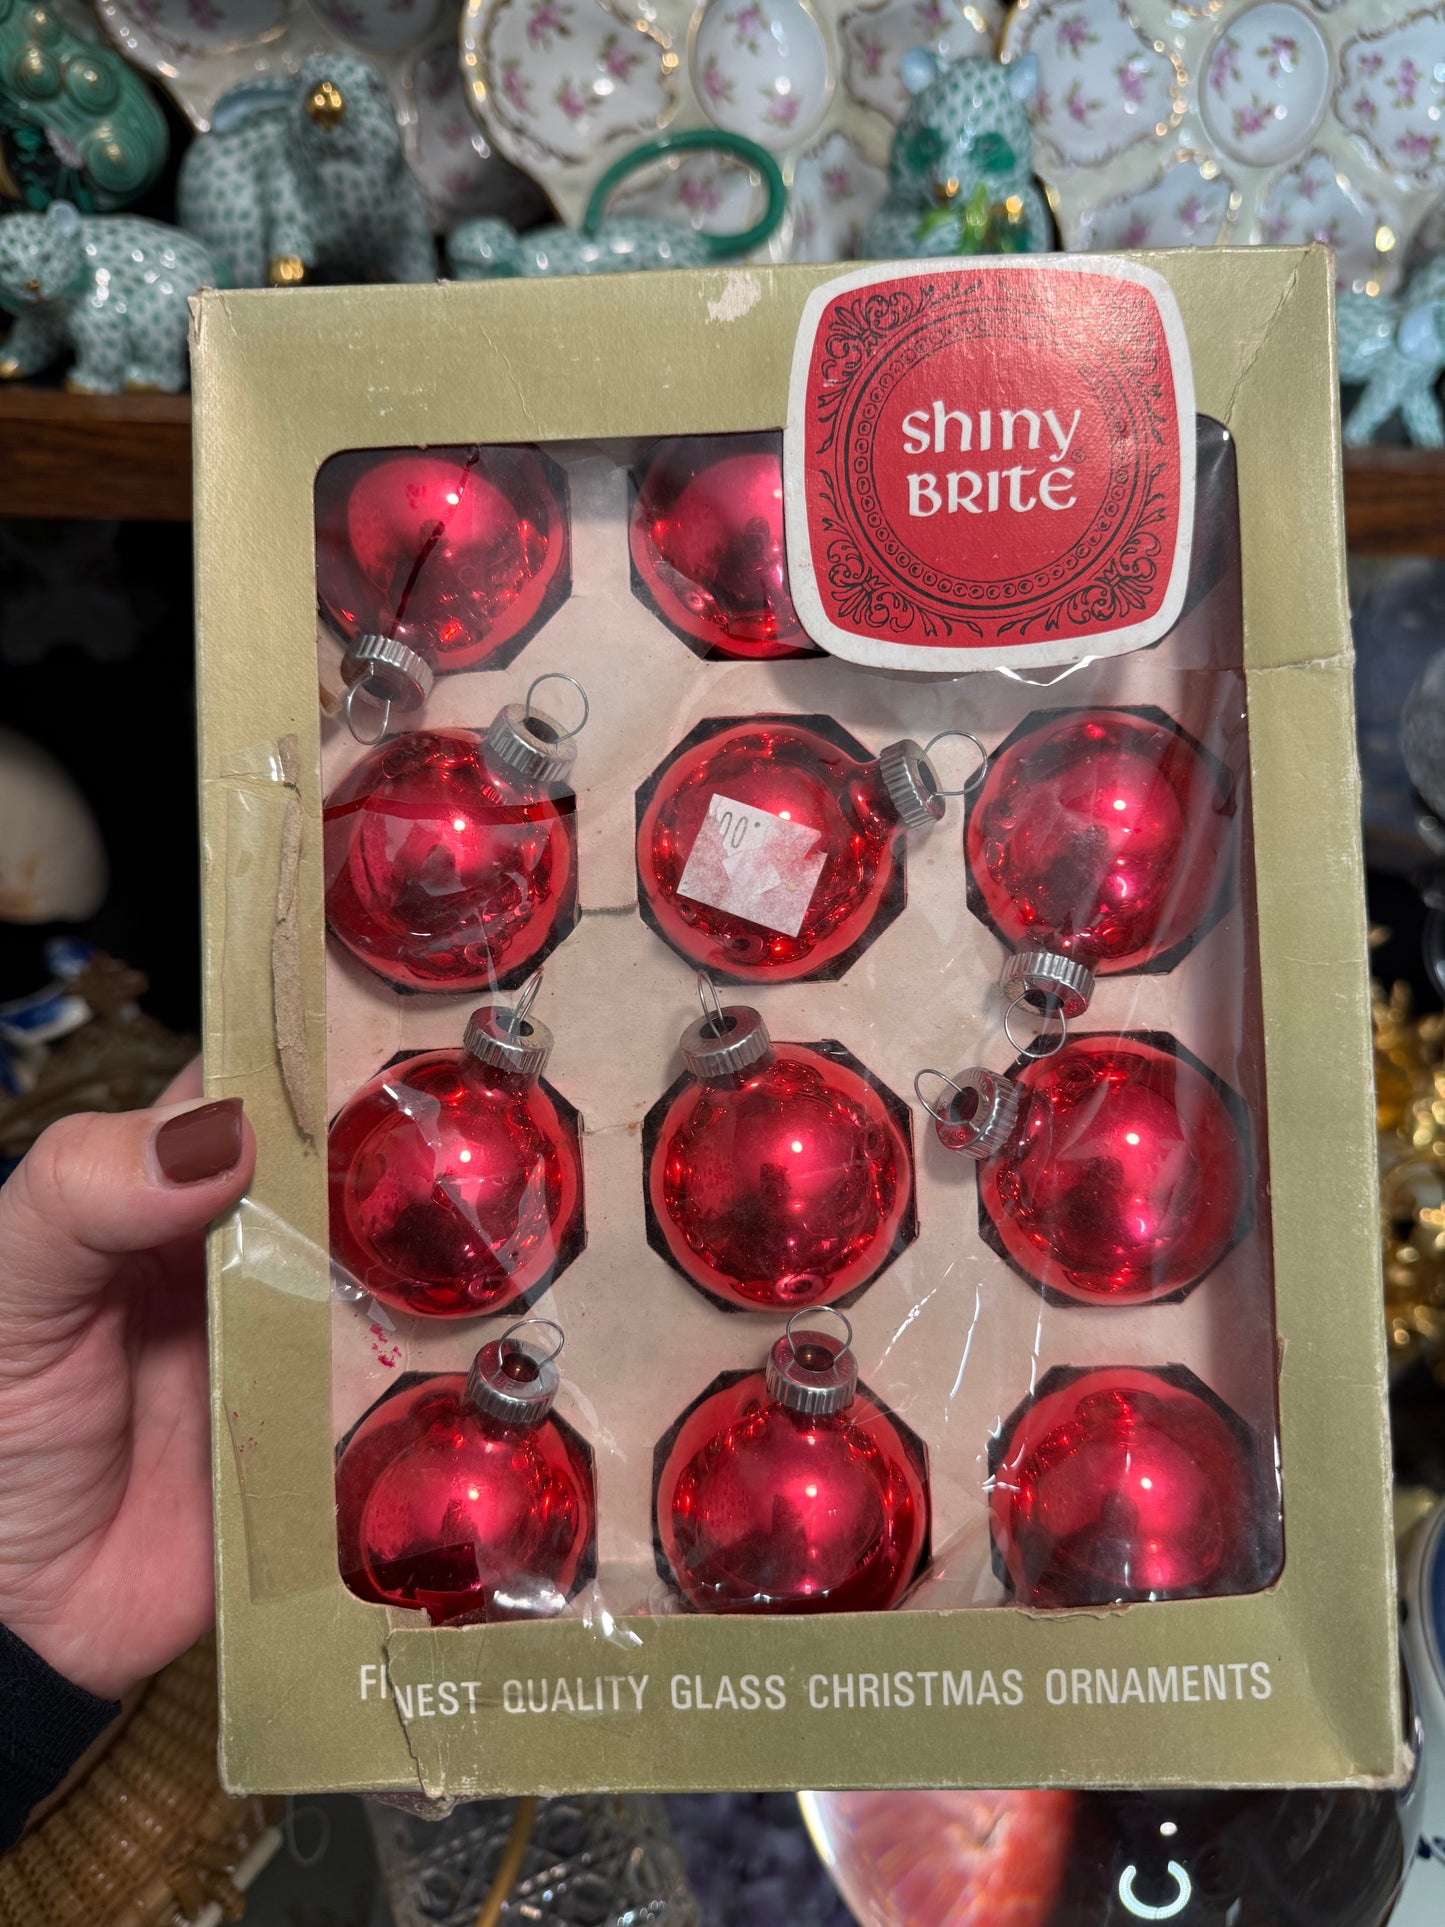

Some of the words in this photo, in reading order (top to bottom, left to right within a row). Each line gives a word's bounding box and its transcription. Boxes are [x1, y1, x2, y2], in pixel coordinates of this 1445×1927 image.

[906, 466, 1078, 517] BRITE
[360, 1664, 482, 1720] FINEST
[502, 1675, 650, 1714] QUALITY
[670, 1674, 787, 1710] GLASS
[808, 1669, 1024, 1709] CHRISTMAS
[1045, 1661, 1272, 1706] ORNAMENTS
